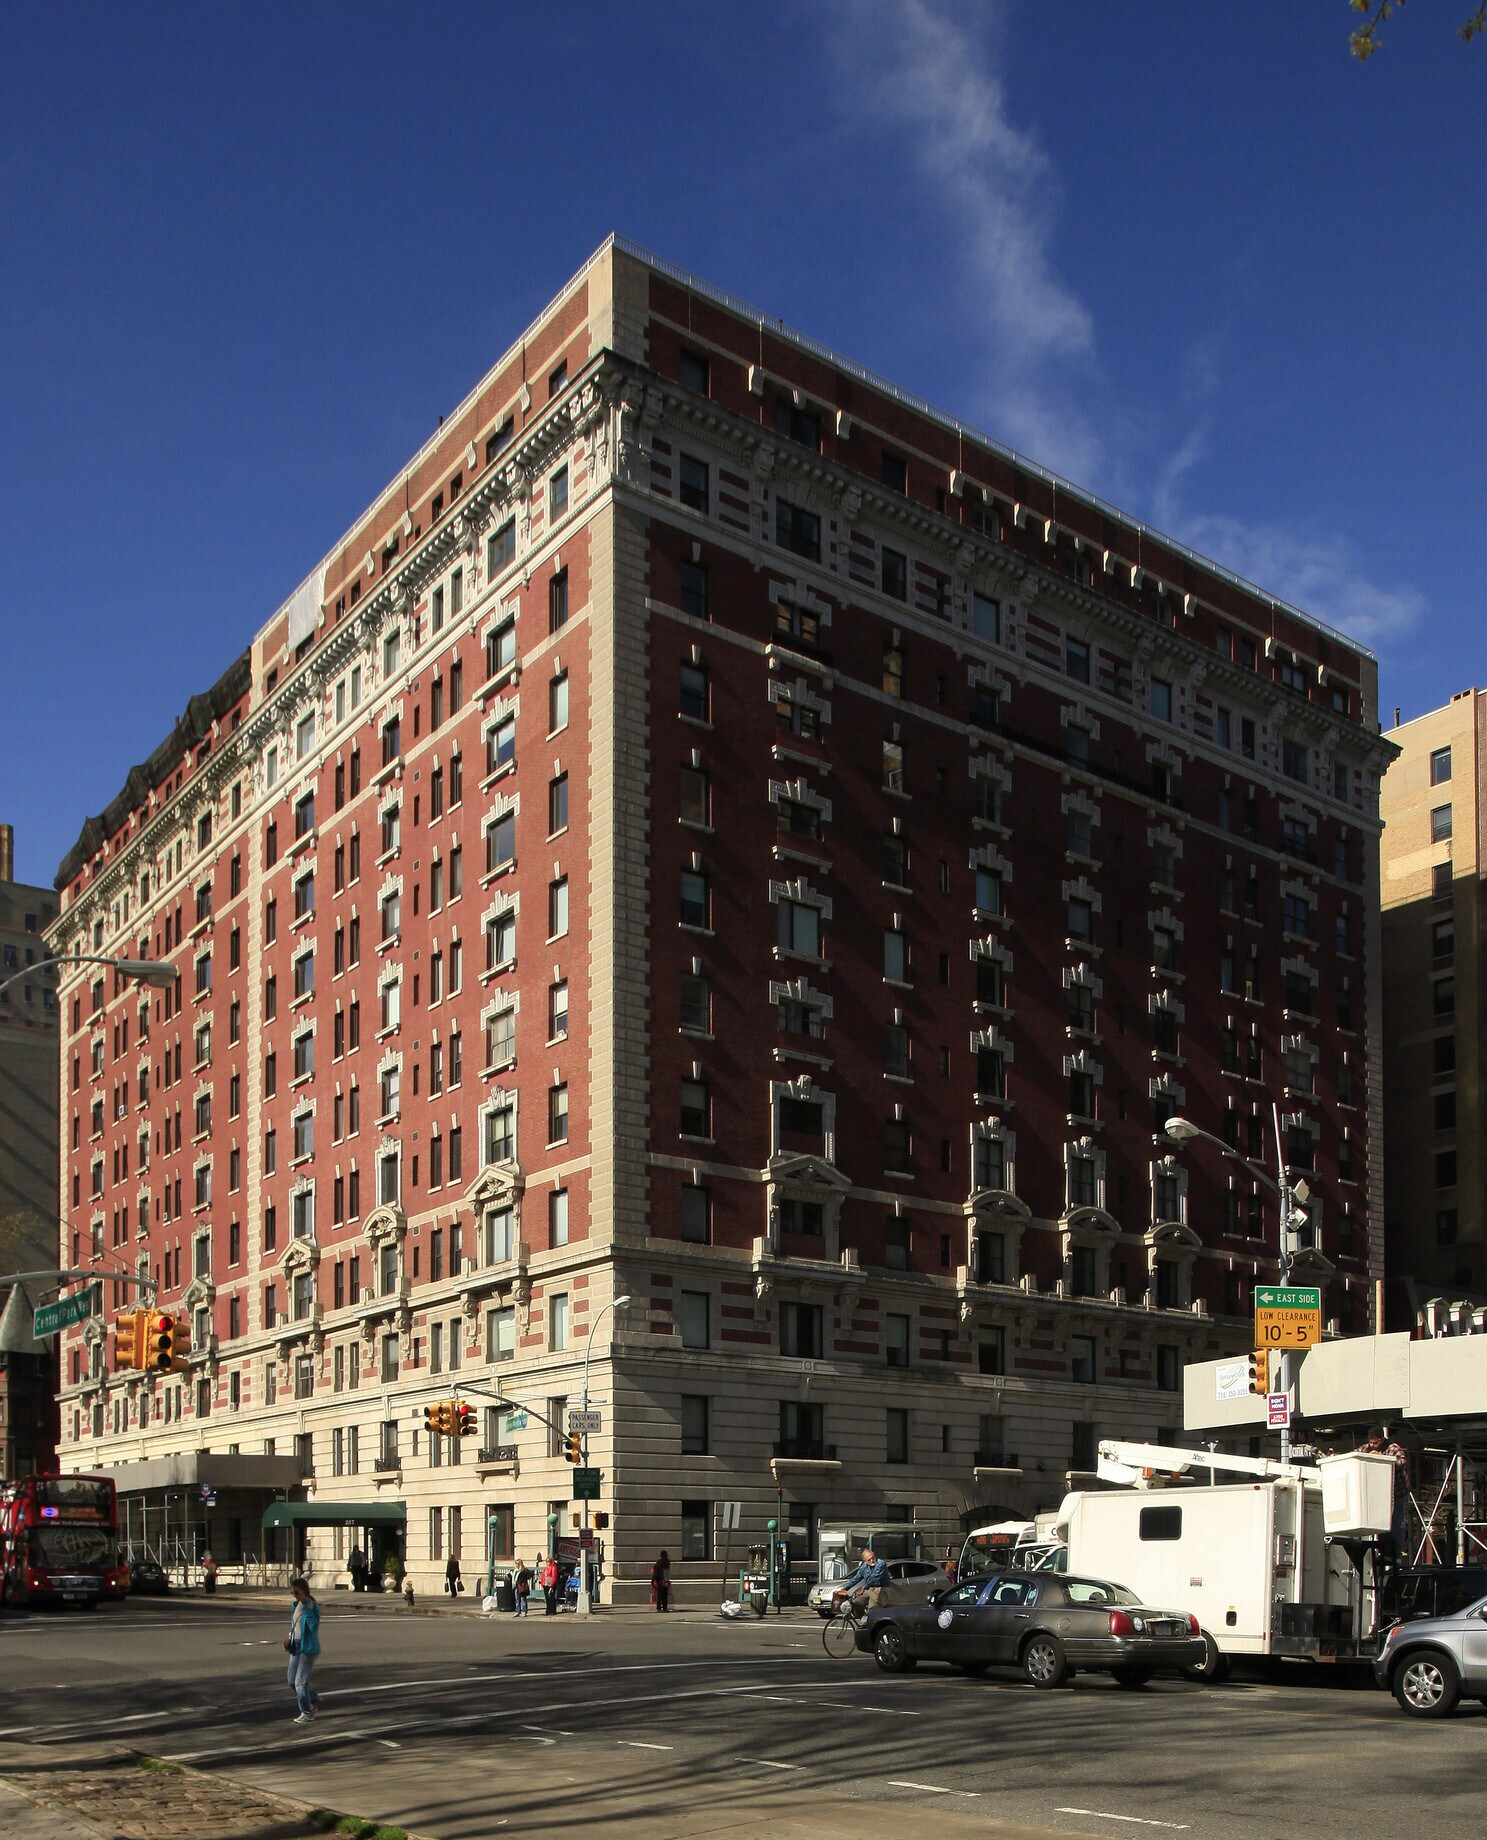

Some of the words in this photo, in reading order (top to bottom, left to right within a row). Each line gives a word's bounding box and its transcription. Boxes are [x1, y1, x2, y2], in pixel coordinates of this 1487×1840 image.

[1277, 1293, 1296, 1303] EAST
[1298, 1294, 1315, 1304] SIDE
[35, 1310, 61, 1330] Central
[60, 1303, 78, 1320] Park
[1260, 1311, 1274, 1320] LOW
[1277, 1311, 1316, 1322] CLEARANCE
[571, 1413, 599, 1421] PASSENGER
